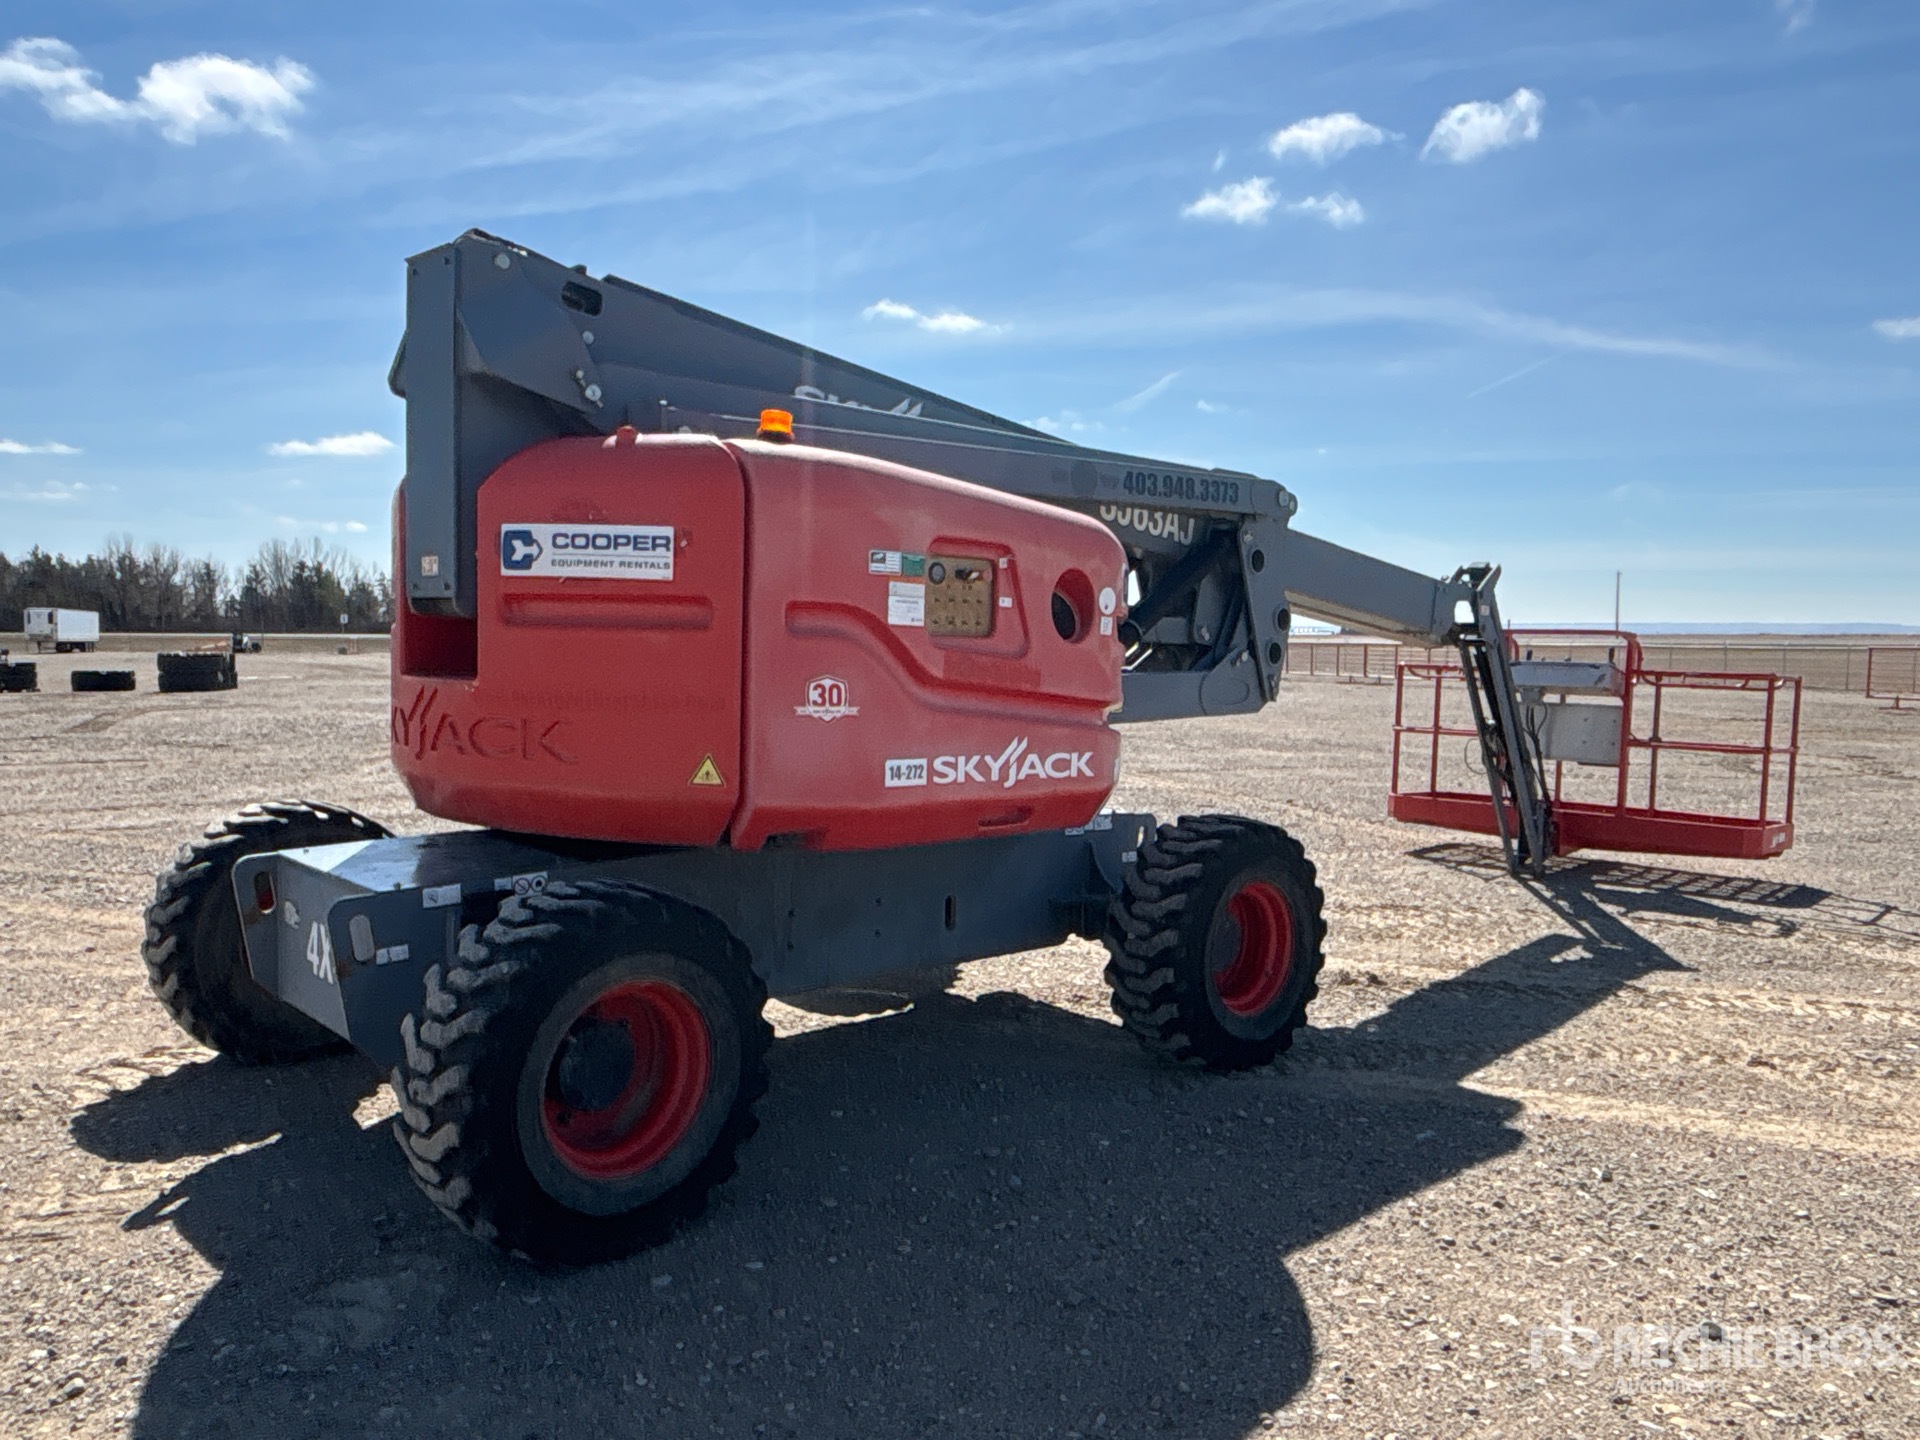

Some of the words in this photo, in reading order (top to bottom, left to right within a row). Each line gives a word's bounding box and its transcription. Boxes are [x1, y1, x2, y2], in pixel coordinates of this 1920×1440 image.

[1123, 470, 1240, 505] 403.948.3373
[551, 532, 672, 552] COOPER
[551, 558, 615, 569] EQUIPMENT
[619, 560, 671, 571] RENTALS
[812, 682, 842, 708] 30
[888, 764, 925, 781] 14-272
[932, 735, 1095, 789] SKYJACK
